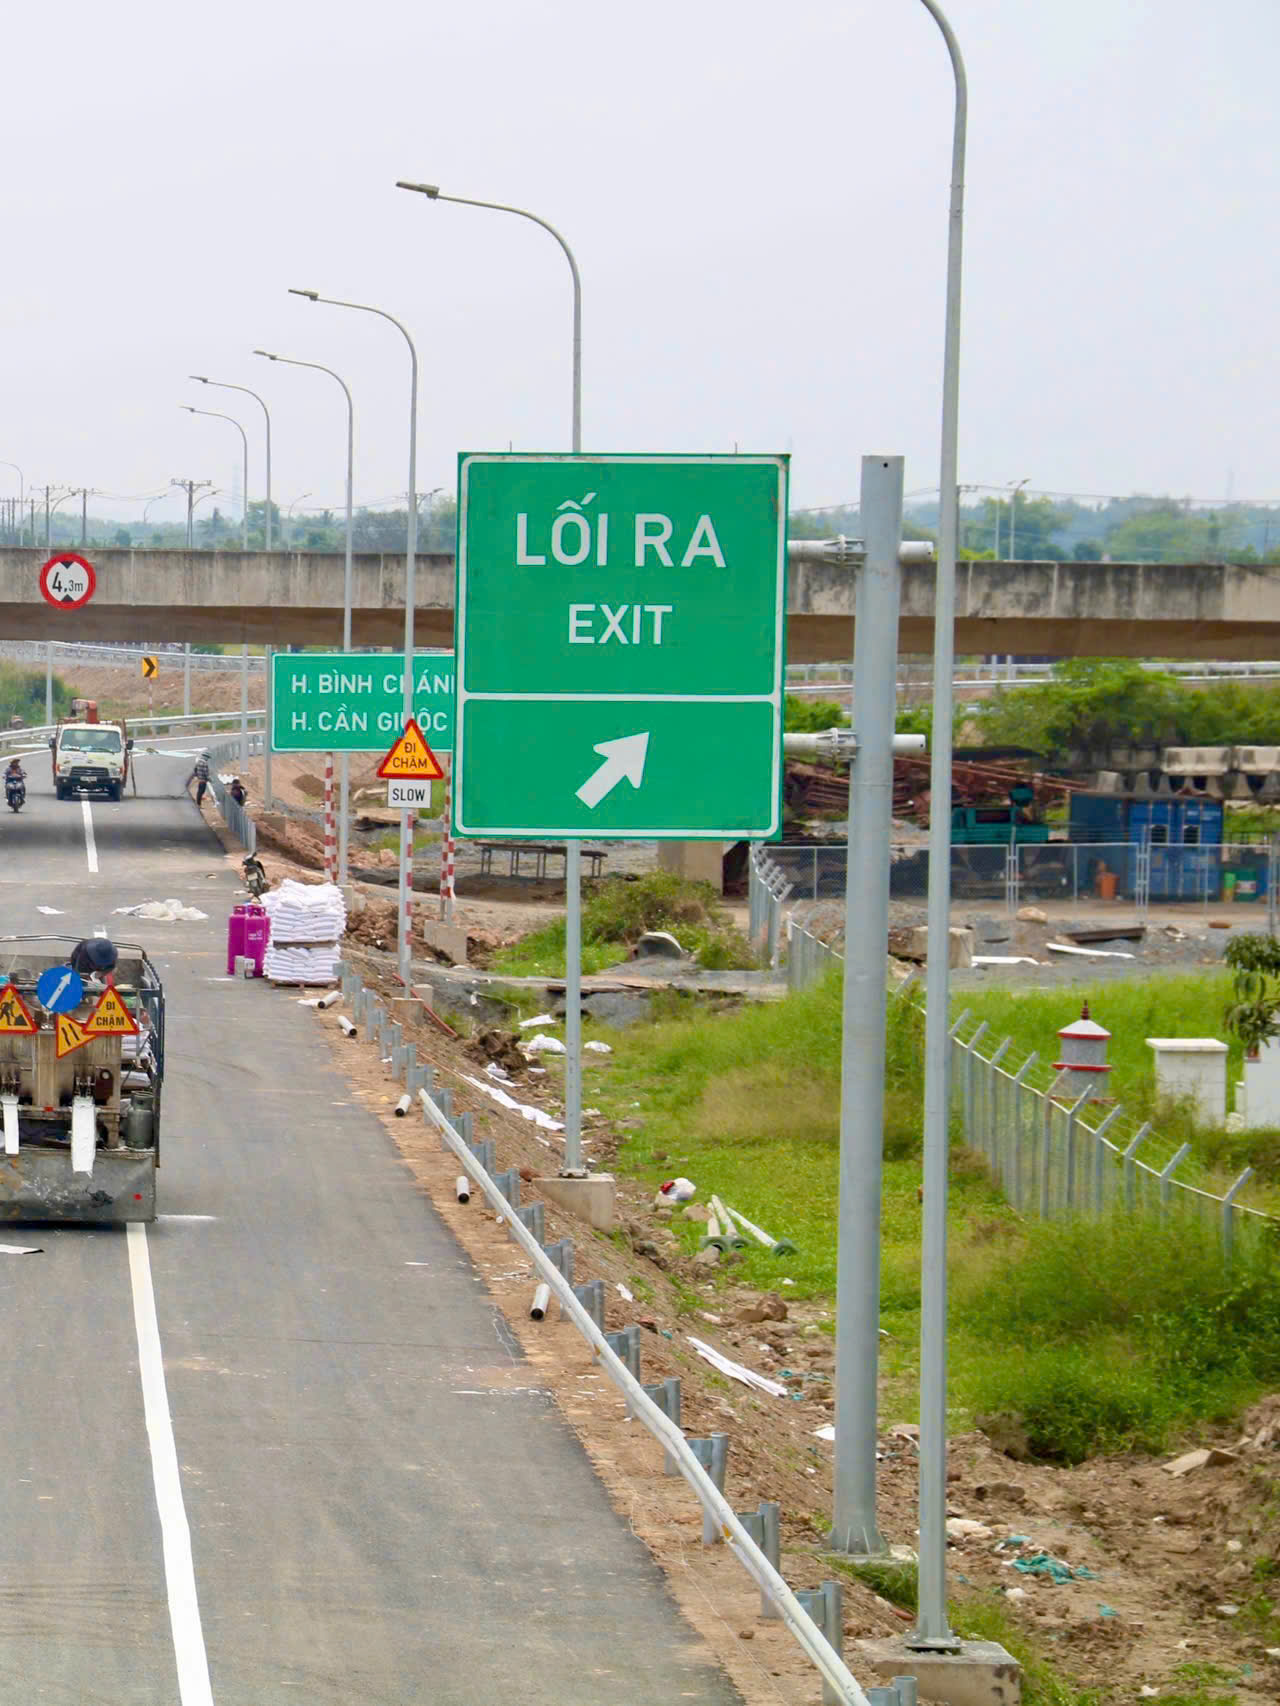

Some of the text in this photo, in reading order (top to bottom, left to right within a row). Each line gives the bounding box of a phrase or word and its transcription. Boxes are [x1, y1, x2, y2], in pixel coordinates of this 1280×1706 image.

[516, 492, 727, 568] LỐI RA
[568, 603, 673, 645] EXIT
[291, 674, 312, 694] H.
[319, 669, 372, 694] BÌNH
[291, 711, 312, 731] H.
[318, 703, 368, 731] CẦN
[404, 742, 417, 753] ĐI
[392, 755, 428, 771] CHẬM
[392, 788, 425, 801] SLOW
[105, 1001, 116, 1010] ĐI
[96, 1014, 125, 1028] CHẬM
